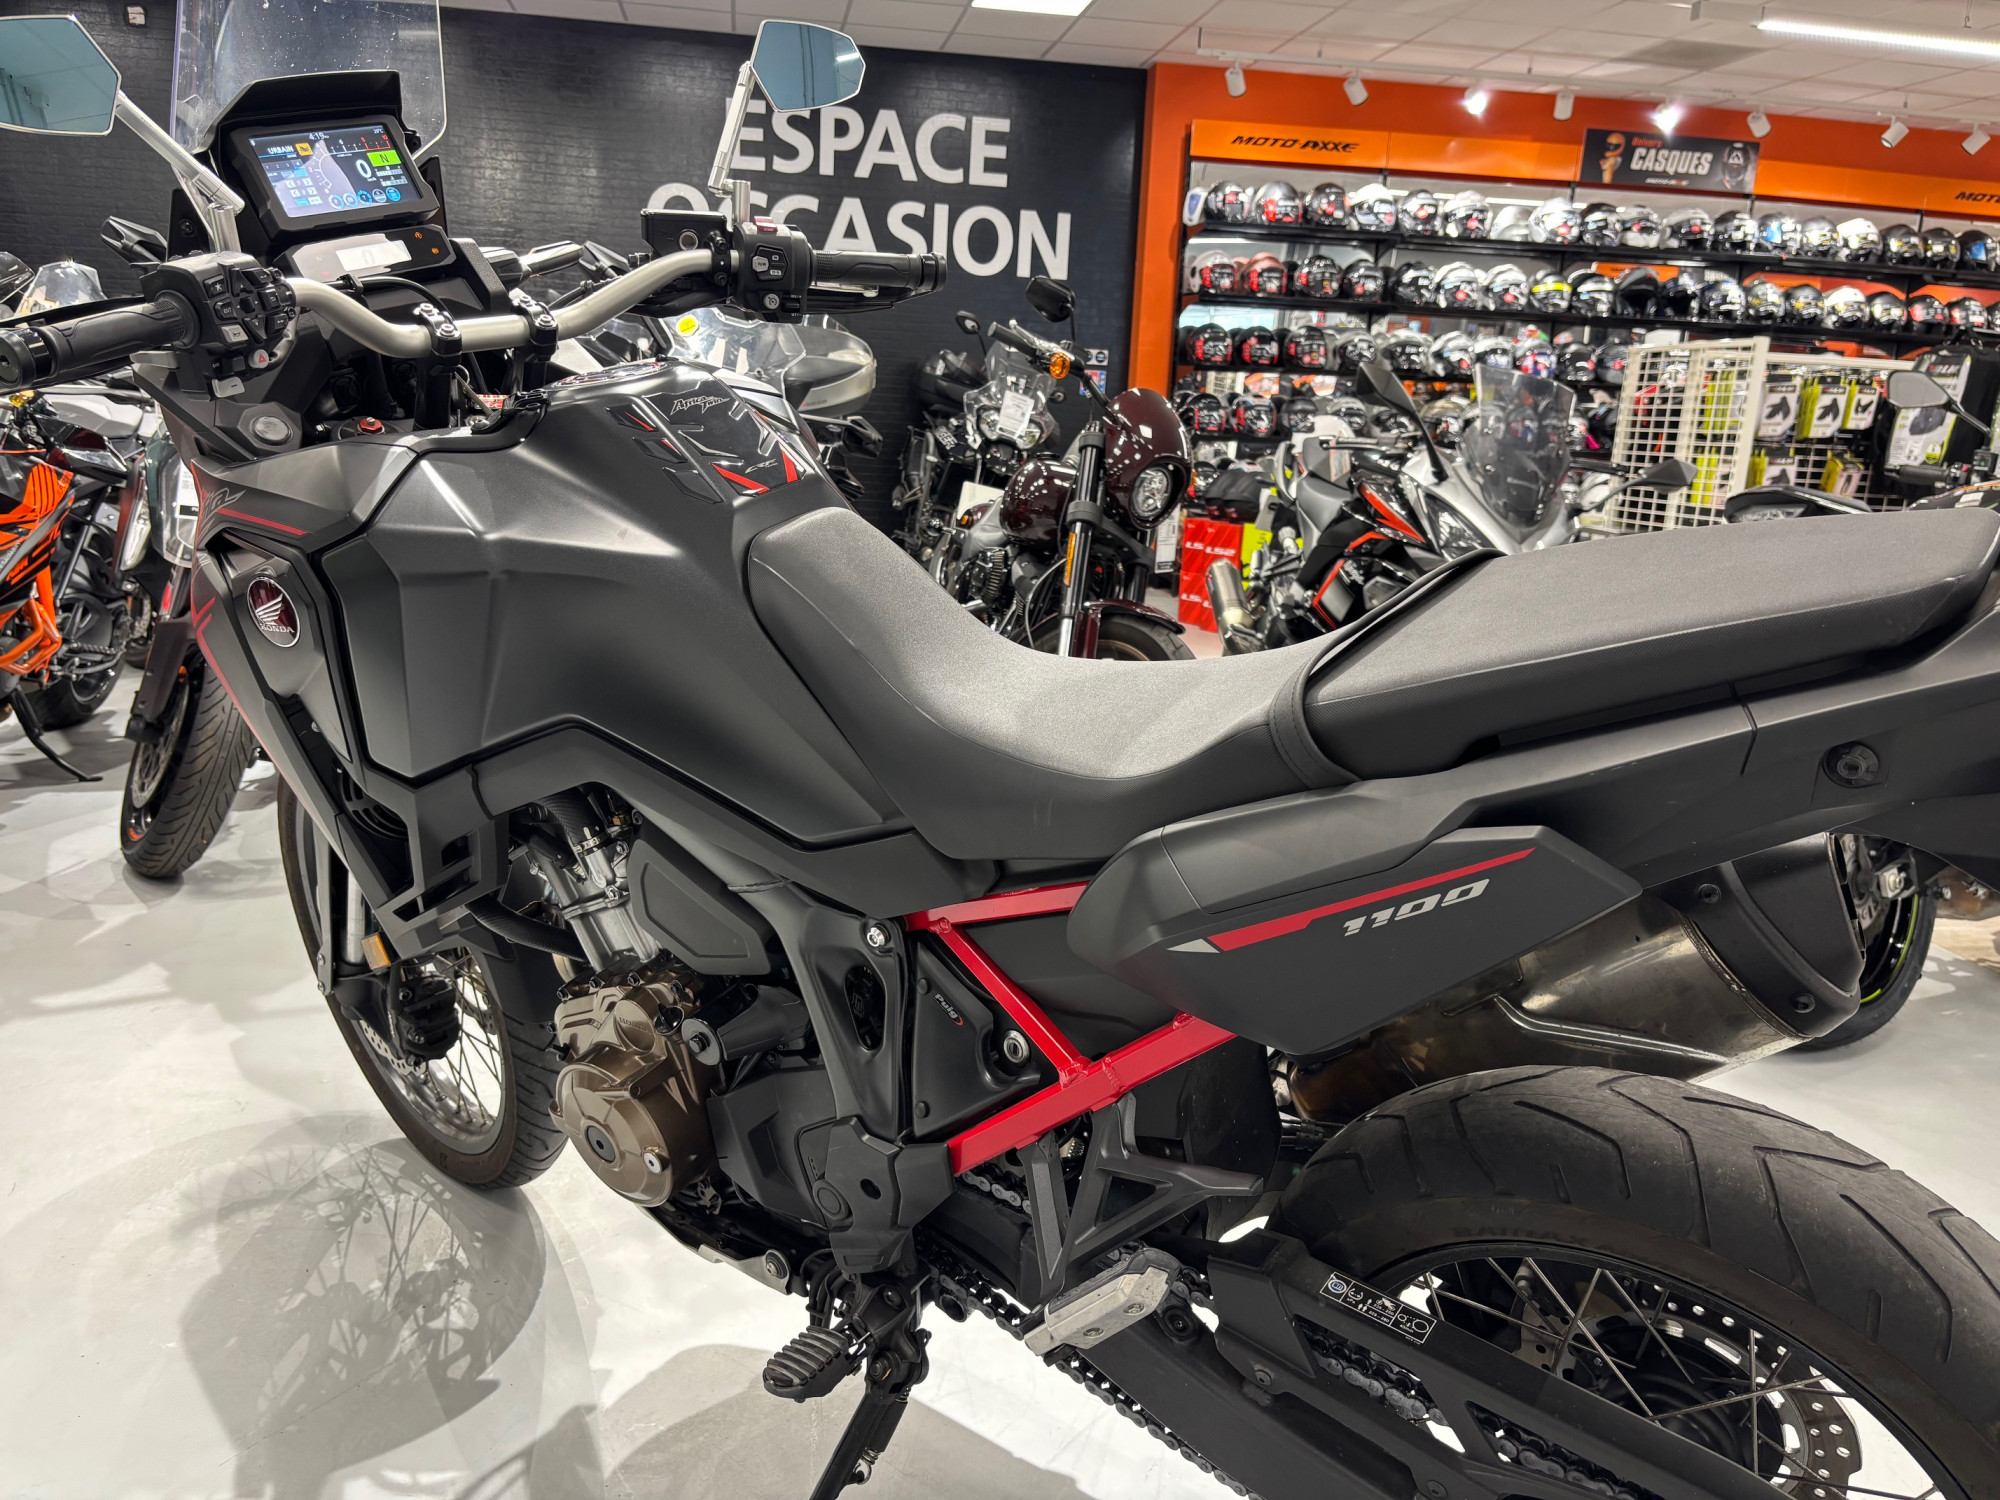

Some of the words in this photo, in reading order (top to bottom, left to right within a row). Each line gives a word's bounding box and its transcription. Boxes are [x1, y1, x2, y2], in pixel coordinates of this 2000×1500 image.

[309, 132, 325, 140] 4:19
[726, 97, 1011, 188] ESPACE
[267, 146, 295, 155] URBAIN
[380, 154, 390, 164] N
[355, 159, 372, 179] 0
[1630, 147, 1713, 176] CASQUES
[670, 395, 707, 416] Africa
[699, 396, 730, 415] Twin
[1185, 541, 1204, 550] LS
[259, 622, 295, 633] HONDA
[1343, 878, 1490, 937] 1100
[934, 993, 959, 1019] Puig
